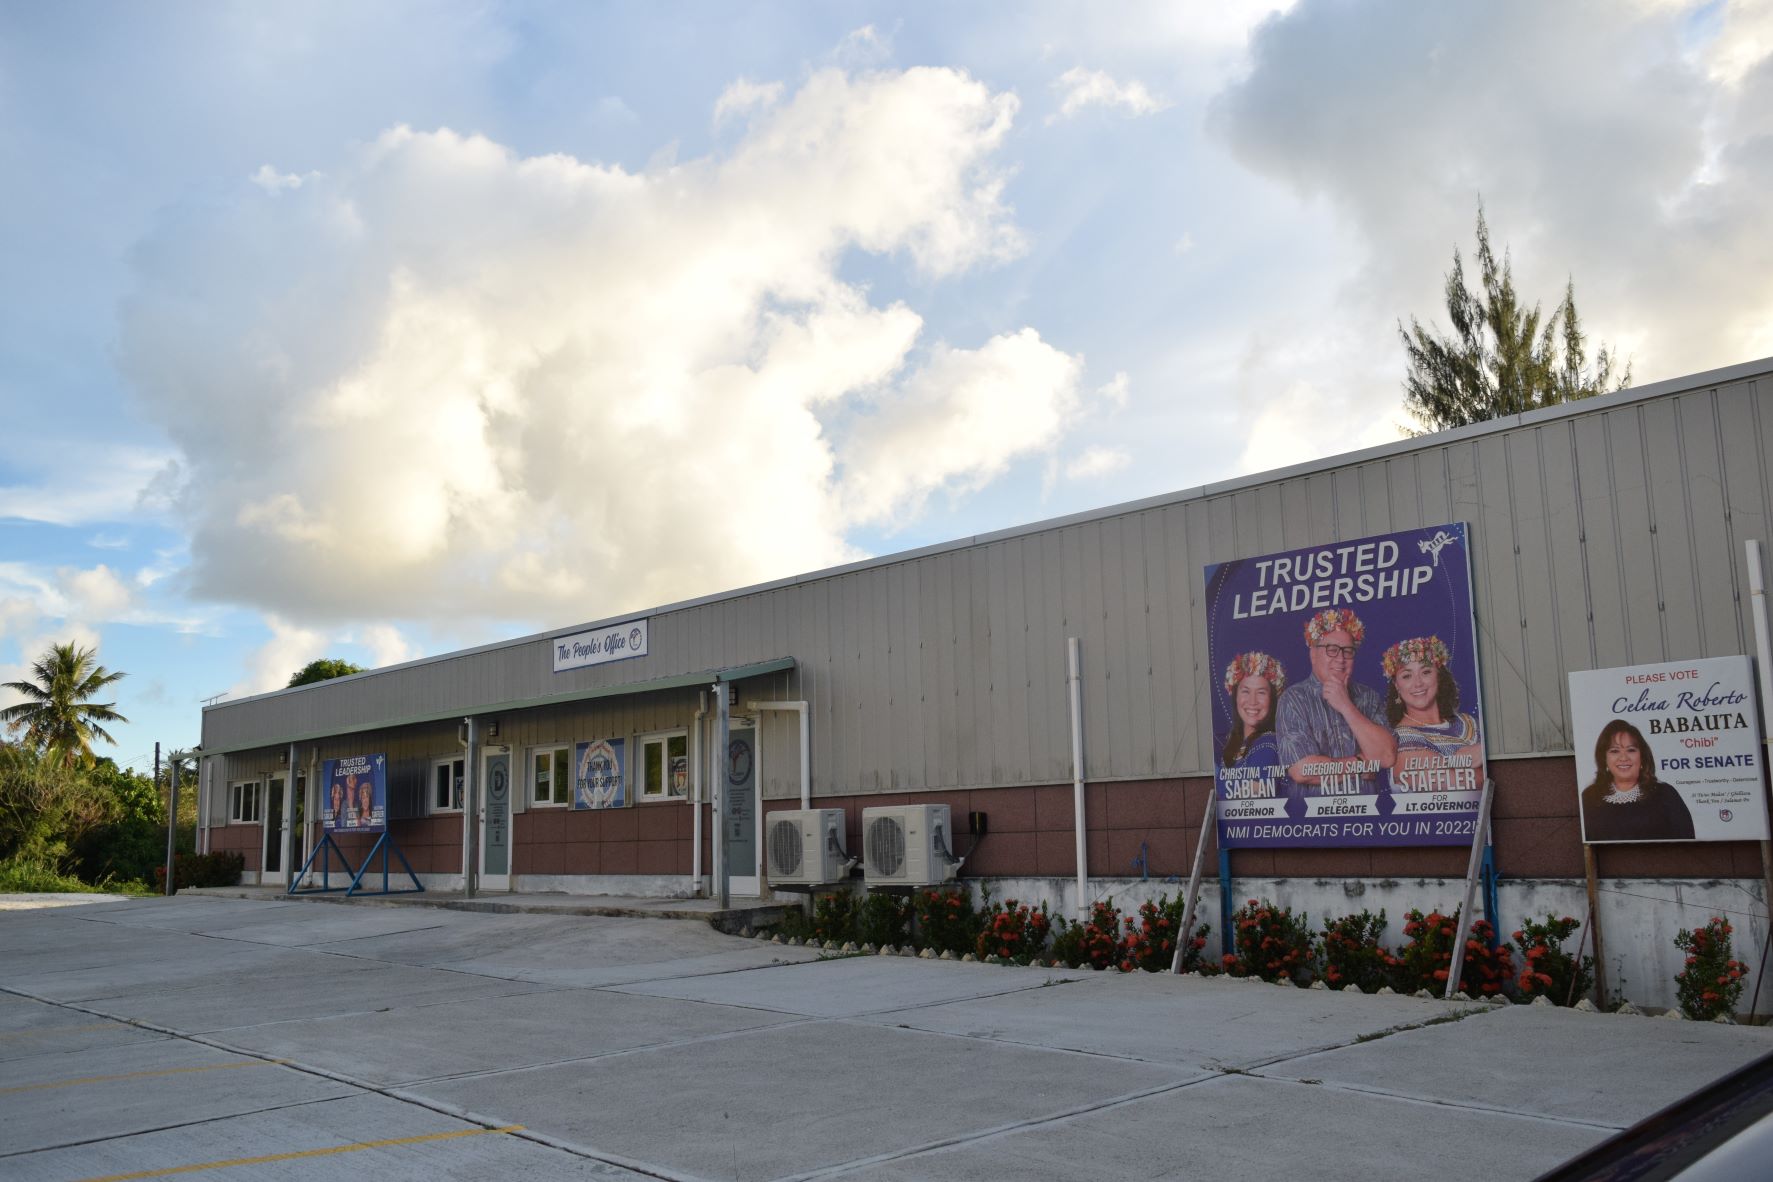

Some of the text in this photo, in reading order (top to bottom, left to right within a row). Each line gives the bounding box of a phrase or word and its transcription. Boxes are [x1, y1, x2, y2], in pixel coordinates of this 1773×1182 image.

[1255, 540, 1400, 588] TRUSTED
[1232, 565, 1433, 620] LEADERSHIP
[558, 633, 626, 662] The People's Office
[1626, 670, 1699, 684] PLEASE VOTE
[1612, 682, 1748, 714] Celina Roberto
[1649, 712, 1749, 735] BABAUTA
[1680, 737, 1719, 749] "Chibi"
[340, 757, 366, 766] TRUSTED
[1302, 759, 1380, 777] GREGORIO SABLAN
[1404, 754, 1473, 770] LEILA FLEMING
[1661, 754, 1755, 770] FOR SENATE
[335, 765, 371, 776] LEADERSHIP
[1219, 766, 1260, 781] CHRISTINA
[1225, 778, 1276, 800] SABLAN
[1320, 774, 1361, 796] KILILI
[1399, 768, 1477, 794] STAFFLER
[1240, 800, 1255, 808] FOR
[1333, 797, 1348, 806] FOR
[1432, 793, 1448, 802] FOR
[1224, 806, 1275, 818] GOVERNOR
[1317, 804, 1367, 816] DELEGATE
[1405, 800, 1480, 812] LT. GOVERNOR
[1226, 820, 1476, 839] NMI DEMOCRATS FOR YOU IN 2022!
